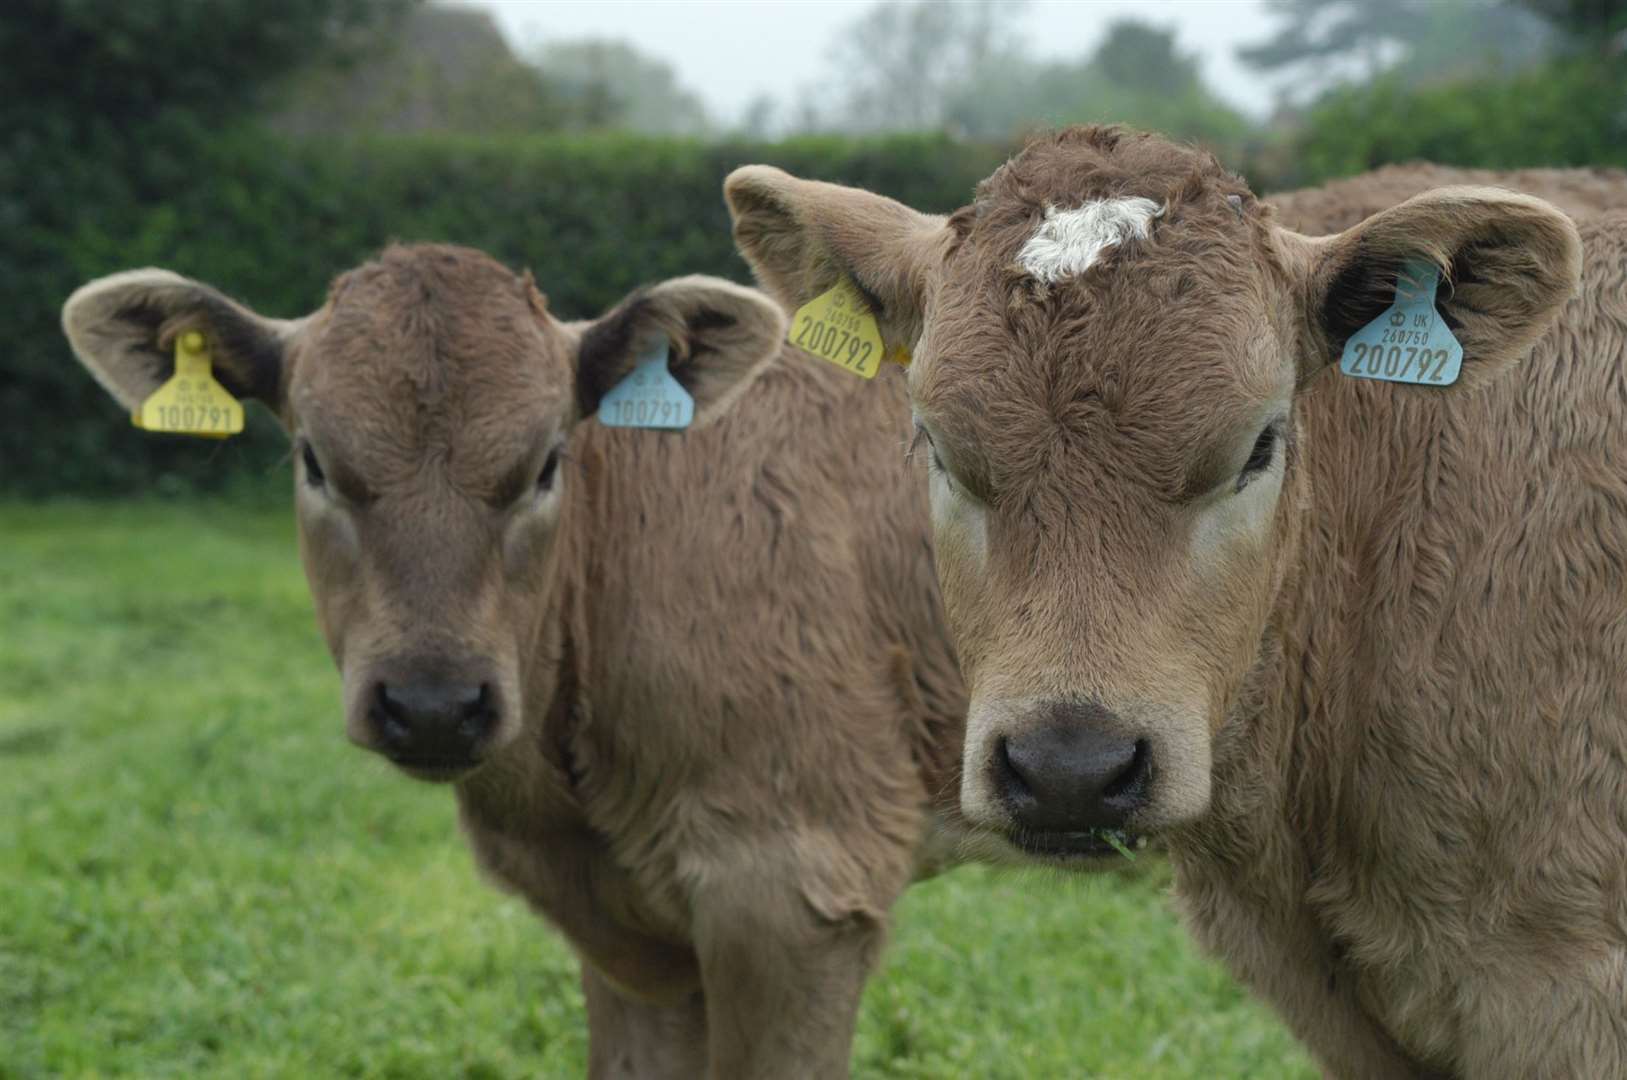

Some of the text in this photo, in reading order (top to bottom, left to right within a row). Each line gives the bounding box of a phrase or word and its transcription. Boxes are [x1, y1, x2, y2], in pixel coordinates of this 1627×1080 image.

[1414, 314, 1427, 327] UK
[795, 315, 872, 372] 200792
[1382, 329, 1429, 345] 260750
[1350, 343, 1448, 382] 200792
[159, 405, 230, 429] 100791
[614, 400, 682, 425] 100791
